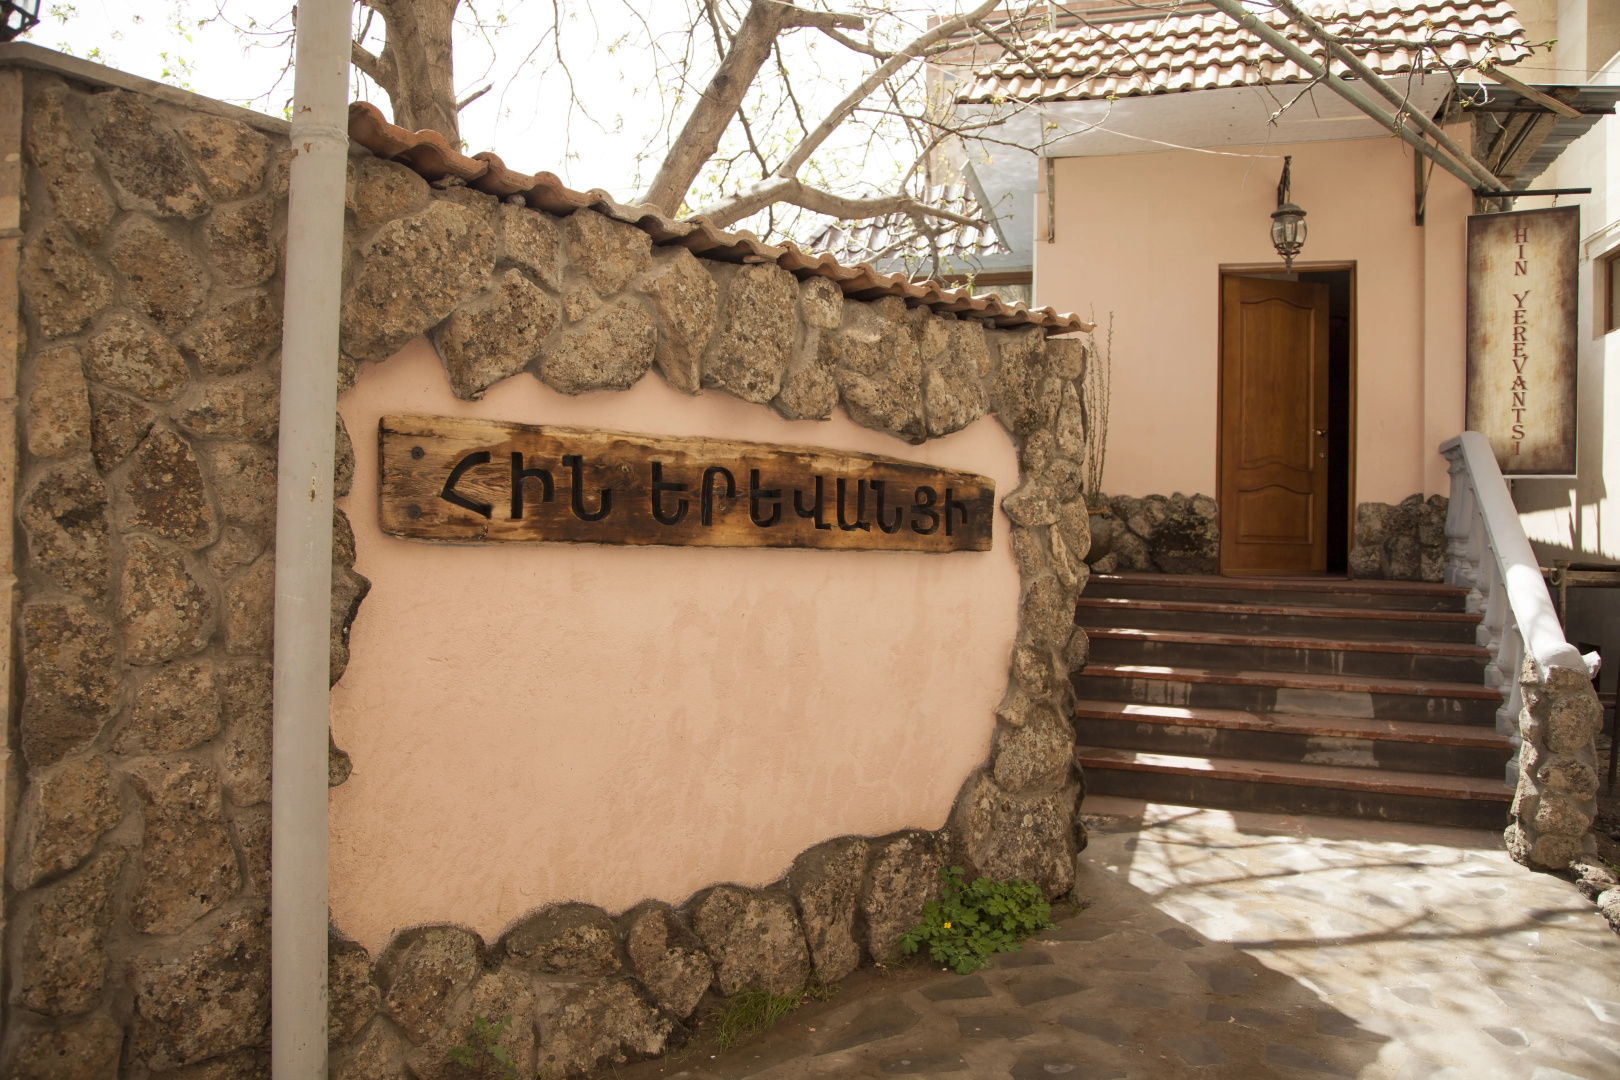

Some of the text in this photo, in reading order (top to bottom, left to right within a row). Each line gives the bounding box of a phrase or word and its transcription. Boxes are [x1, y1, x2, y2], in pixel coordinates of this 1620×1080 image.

[1511, 227, 1530, 456] HIN YEREVANTSI
[440, 451, 612, 522] ՀԻՆ
